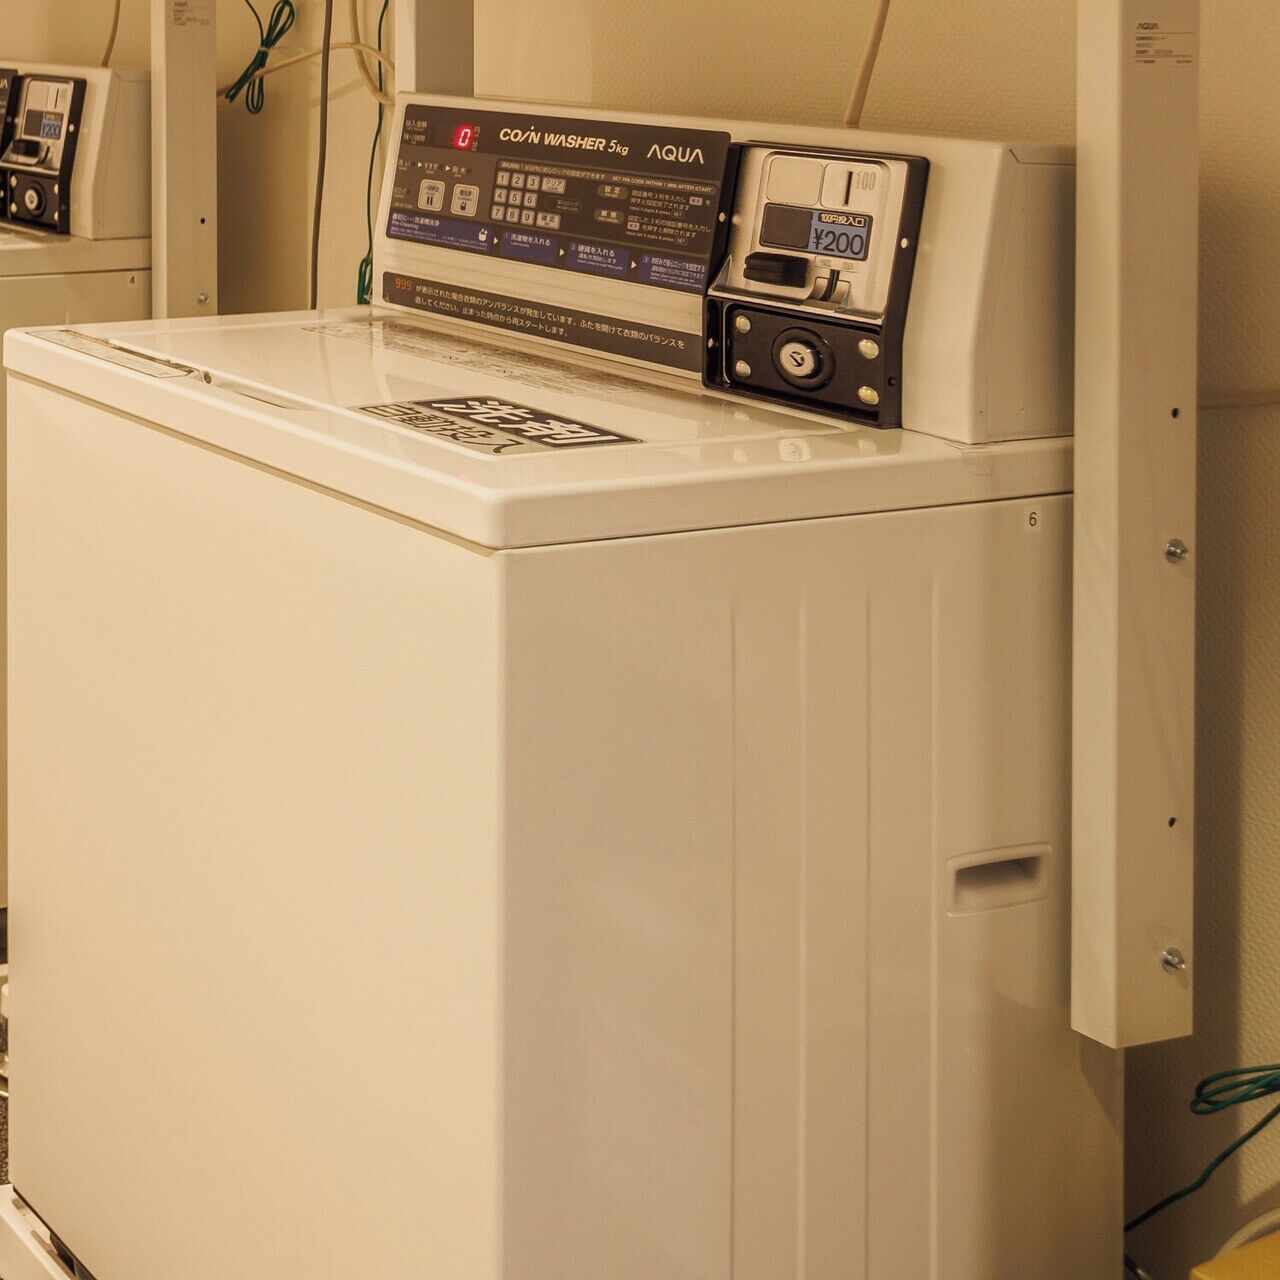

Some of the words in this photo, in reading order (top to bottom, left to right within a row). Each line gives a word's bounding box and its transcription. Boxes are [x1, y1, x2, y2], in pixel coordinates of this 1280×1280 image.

[1136, 22, 1159, 31] AQUA
[458, 128, 471, 147] 0
[499, 126, 540, 144] COIN
[544, 134, 606, 152] WASHER
[608, 139, 630, 156] 5kg
[647, 144, 705, 164] AQUA
[630, 177, 645, 185] CODE
[645, 179, 663, 187] WITHIN
[678, 183, 694, 191] AFTER
[694, 185, 712, 193] START
[820, 213, 865, 227] 100円投入口
[812, 227, 865, 256] ¥200
[432, 400, 620, 445] 洗剤
[1028, 511, 1038, 527] 6
